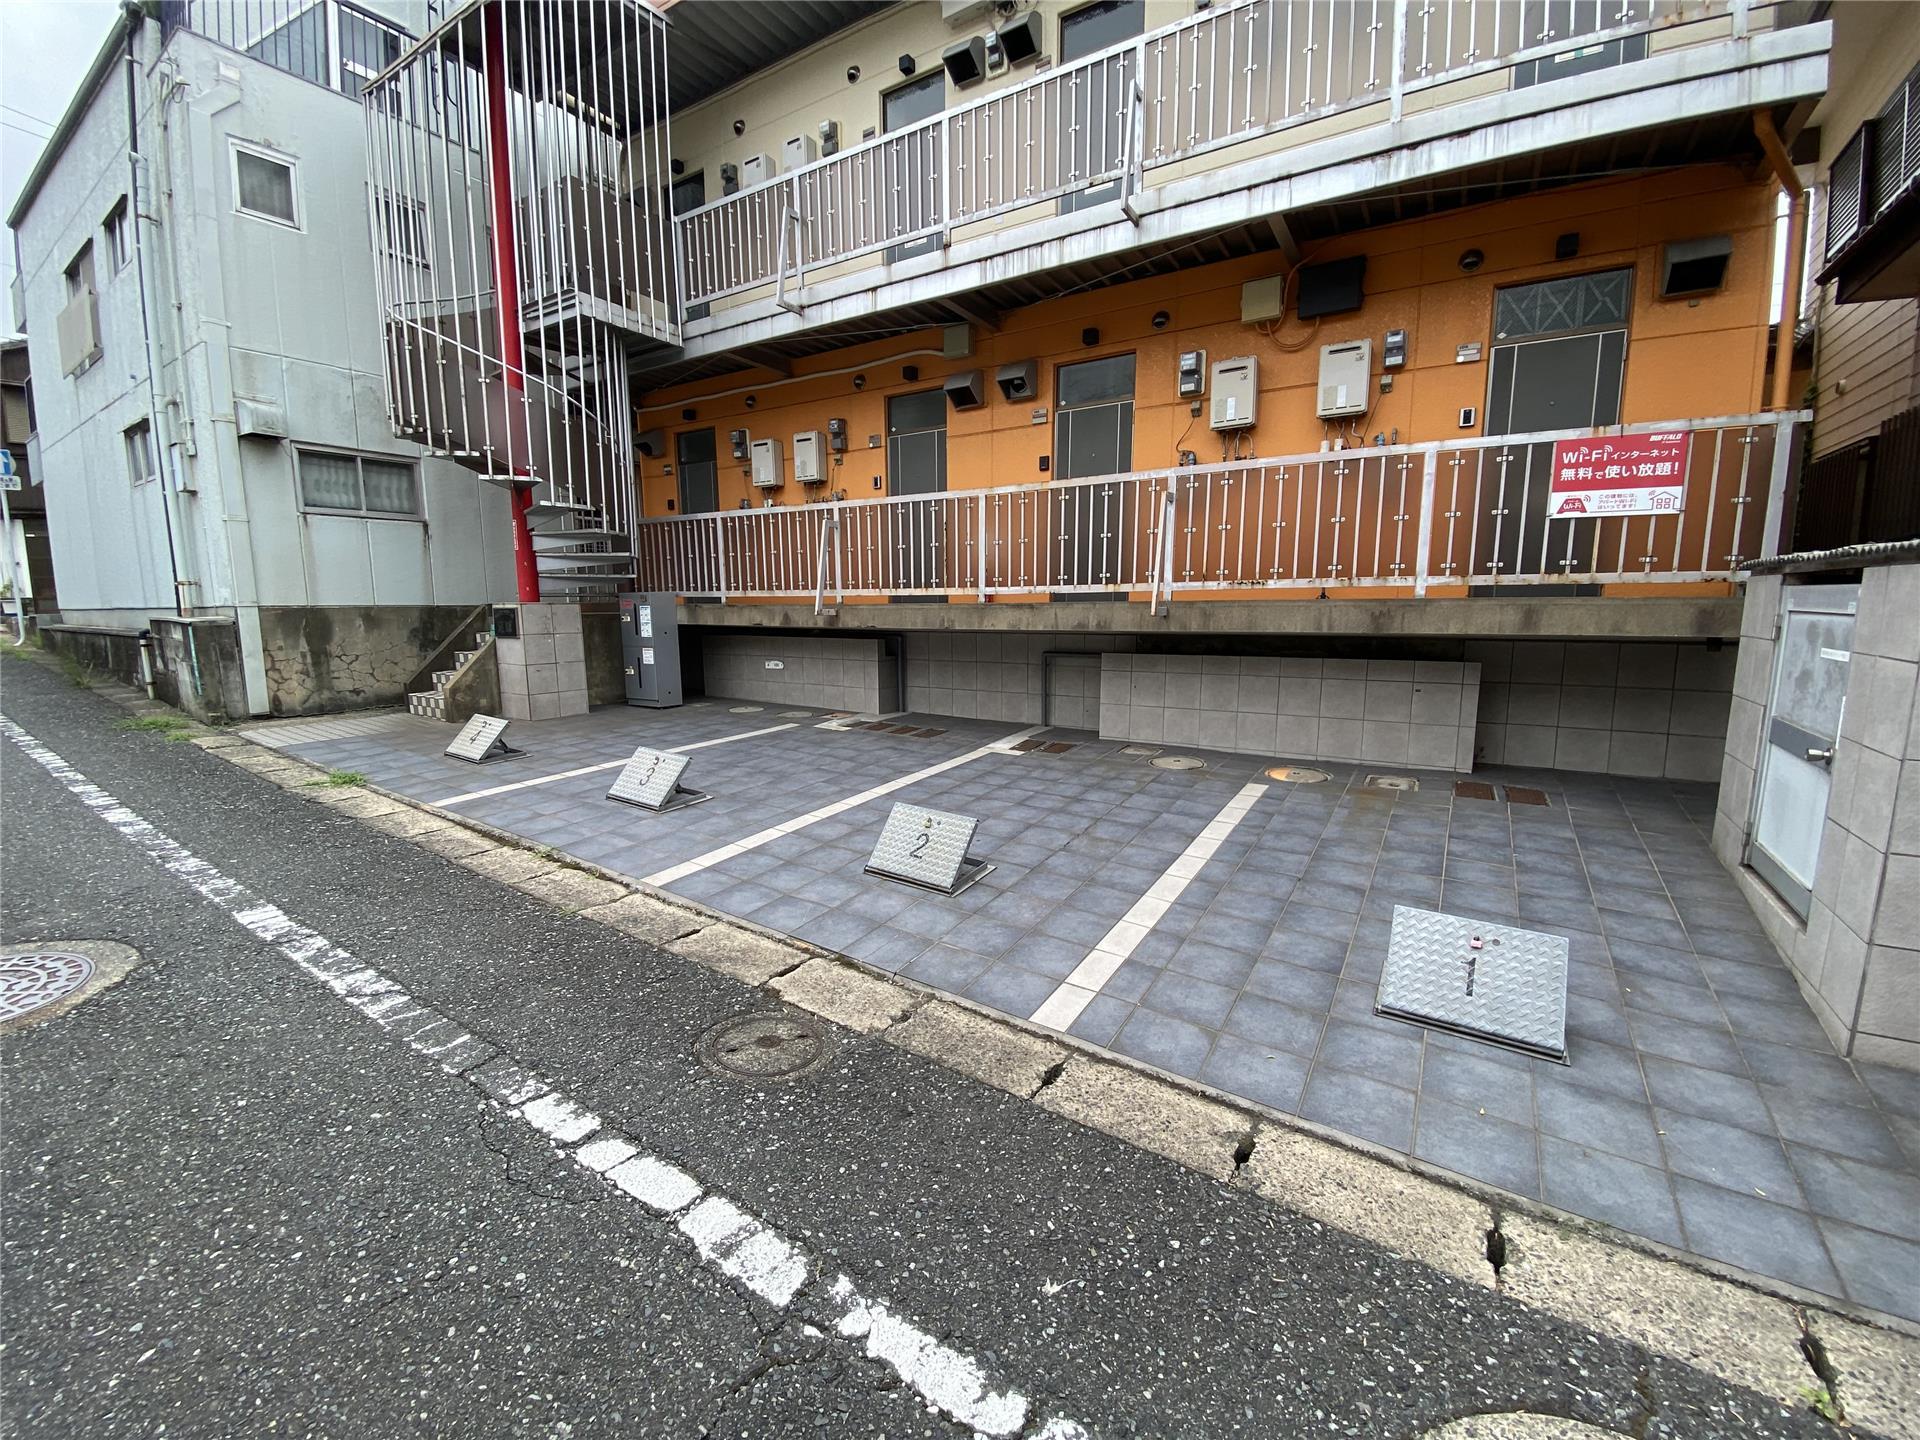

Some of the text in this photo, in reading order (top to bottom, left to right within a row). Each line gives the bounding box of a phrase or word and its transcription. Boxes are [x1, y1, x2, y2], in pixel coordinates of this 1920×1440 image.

[1649, 433, 1682, 441] BUFFALO
[1560, 462, 1680, 481] 無料で使い放題!
[470, 729, 482, 745] 4
[639, 767, 656, 786] 3
[909, 832, 930, 860] 2
[1460, 957, 1477, 997] 1
